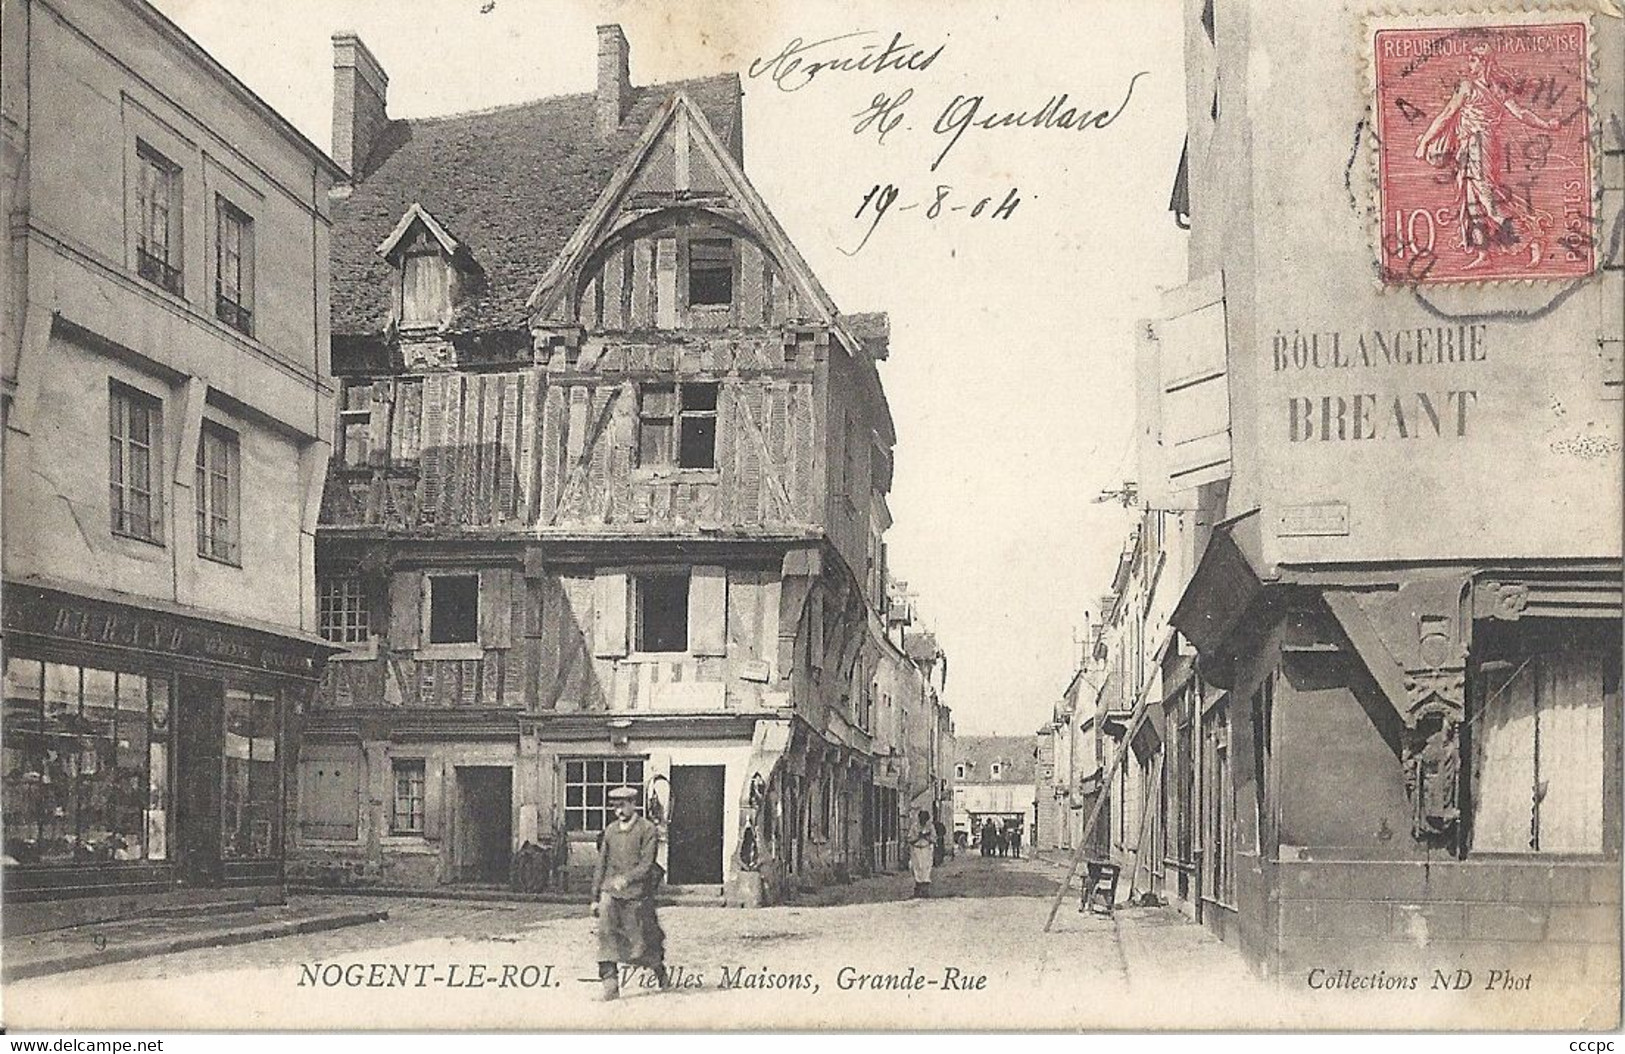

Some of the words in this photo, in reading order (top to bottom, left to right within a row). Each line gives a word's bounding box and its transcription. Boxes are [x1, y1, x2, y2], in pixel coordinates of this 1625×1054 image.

[1563, 178, 1582, 263] POSTES
[1272, 323, 1487, 372] BOULANGERIE
[1289, 390, 1478, 442] BREANT
